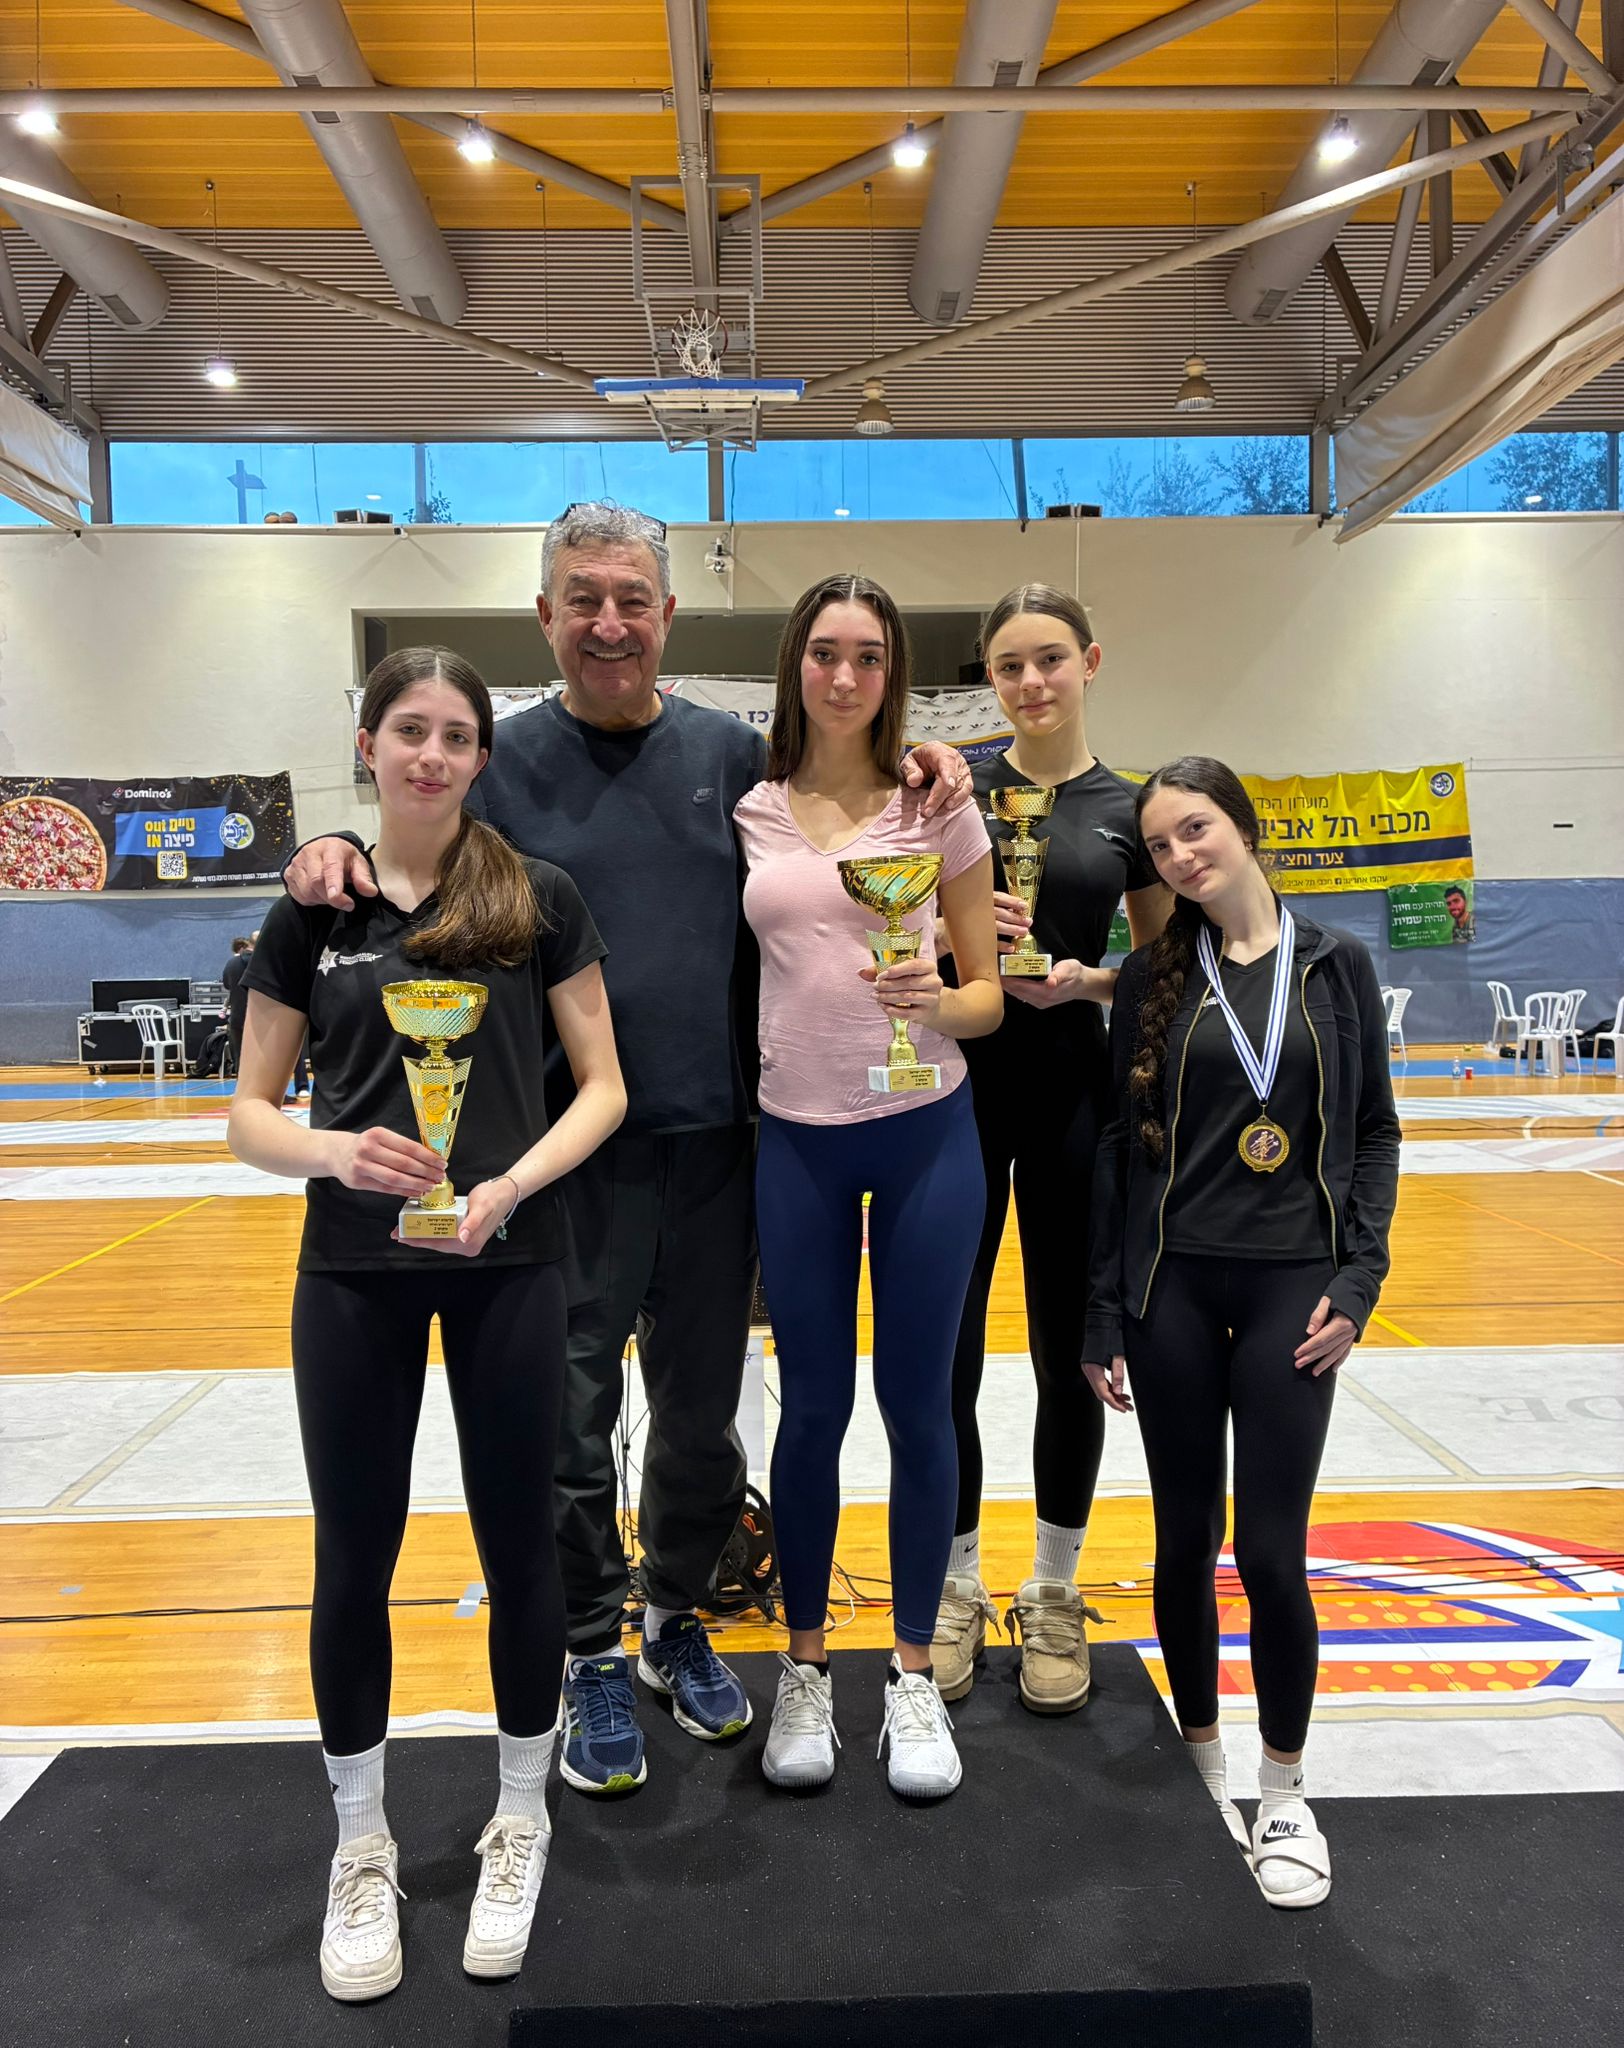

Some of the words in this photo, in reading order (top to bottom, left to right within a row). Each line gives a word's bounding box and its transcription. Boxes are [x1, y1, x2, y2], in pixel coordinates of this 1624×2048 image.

[748, 709, 775, 723] כז
[125, 788, 172, 799] Domino's
[1288, 796, 1329, 812] מועדון
[169, 817, 195, 831] טיים
[1323, 814, 1359, 838] תל
[1370, 810, 1431, 835] מכבי
[164, 833, 195, 848] פיצה
[1281, 853, 1312, 866] וחצי
[1315, 851, 1344, 866] צעד
[1412, 902, 1424, 910] עם
[1425, 901, 1445, 909] תהיה
[1424, 914, 1447, 923] תהיה
[82, 1024, 89, 1034] 1
[1267, 1819, 1302, 1836] NIKE
